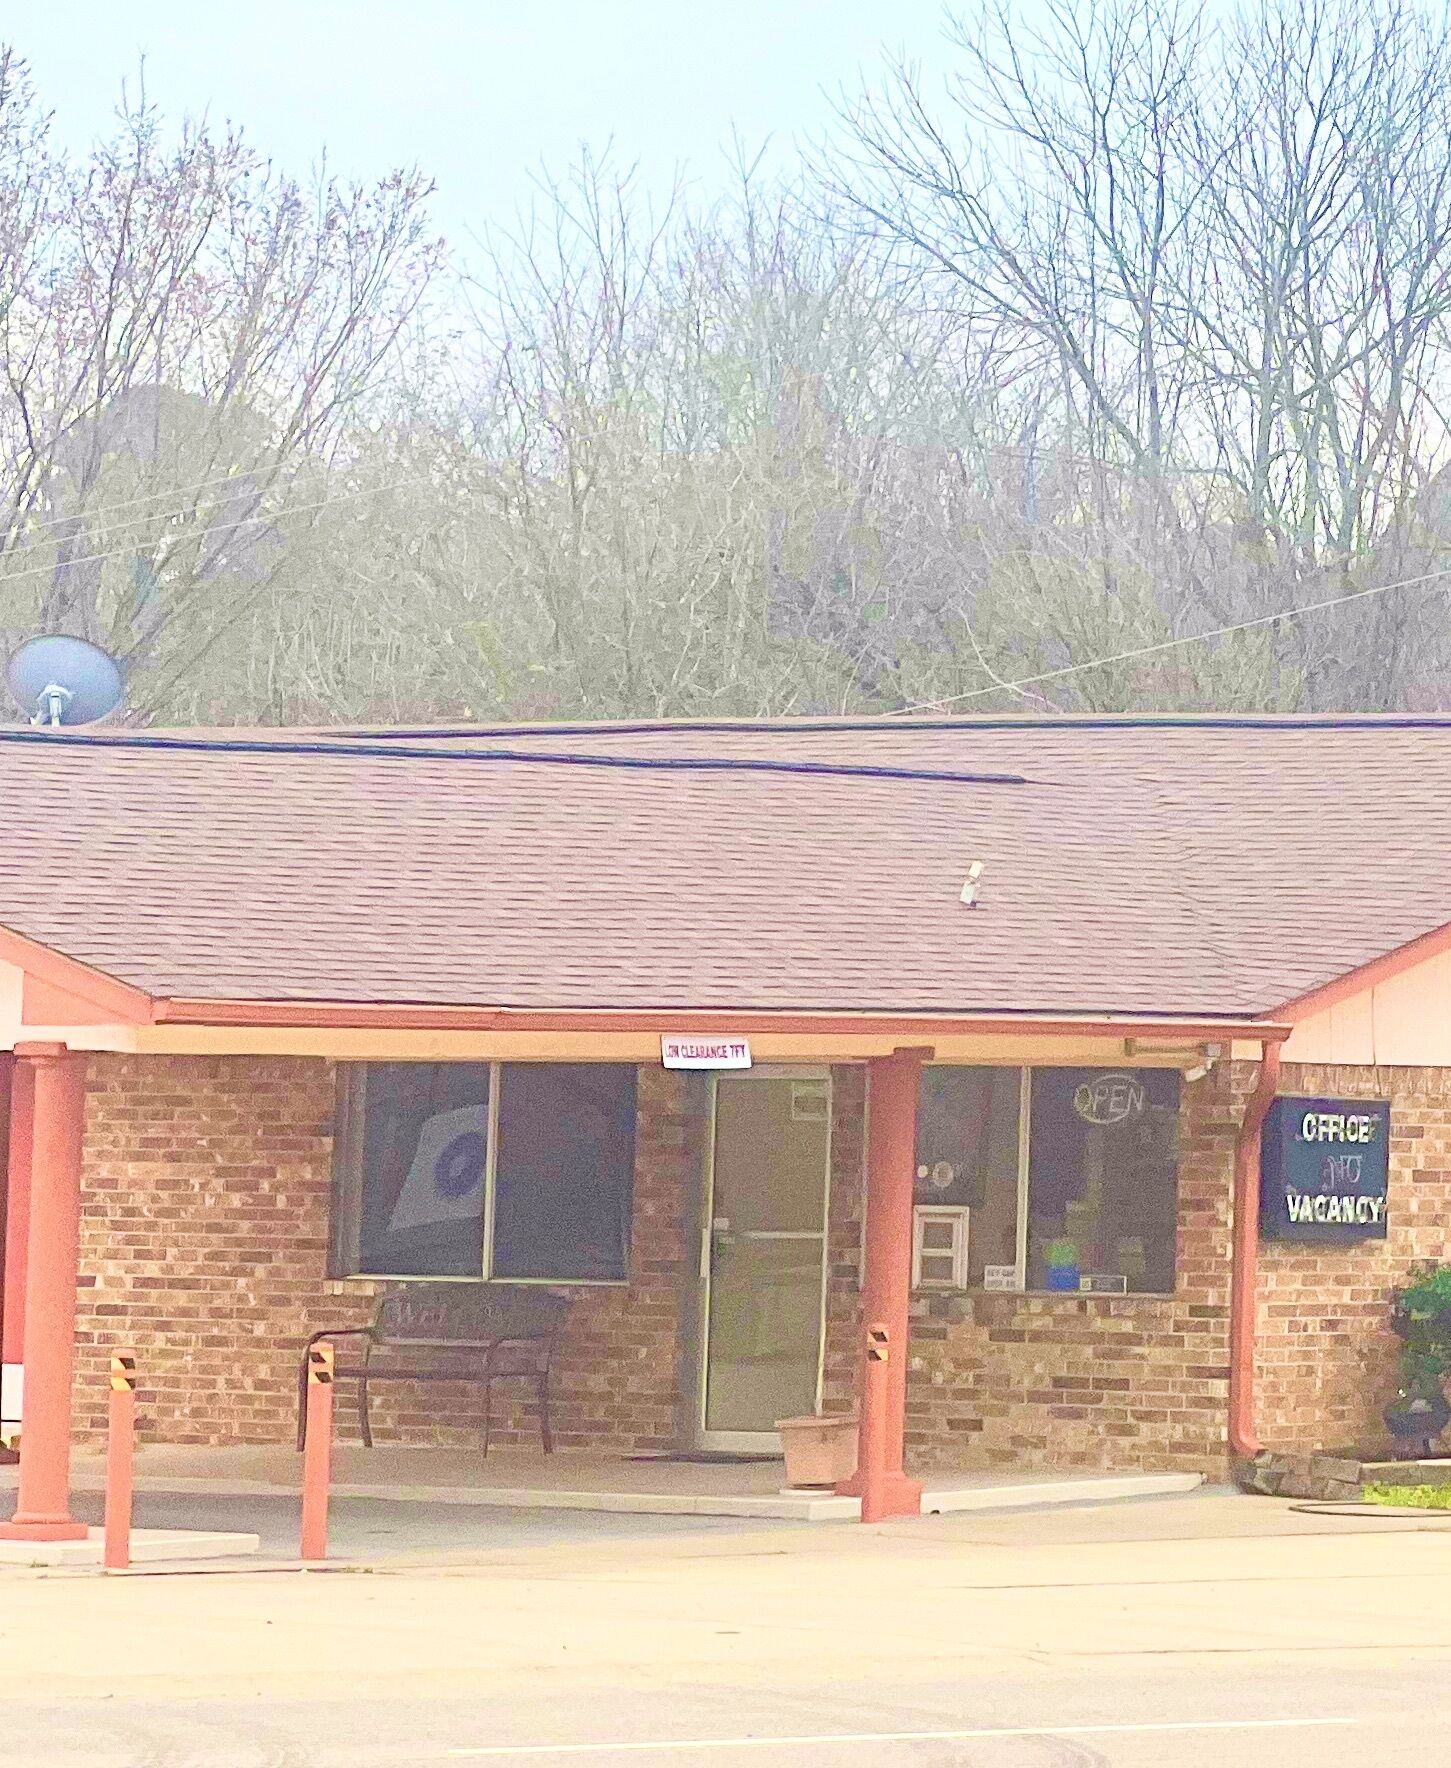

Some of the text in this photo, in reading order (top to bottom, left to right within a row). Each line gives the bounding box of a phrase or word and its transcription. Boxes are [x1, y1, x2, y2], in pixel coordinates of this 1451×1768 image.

[1073, 1083, 1146, 1113] OPEN
[1302, 1112, 1371, 1143] OFFICE
[1286, 1193, 1385, 1224] VACANCY
